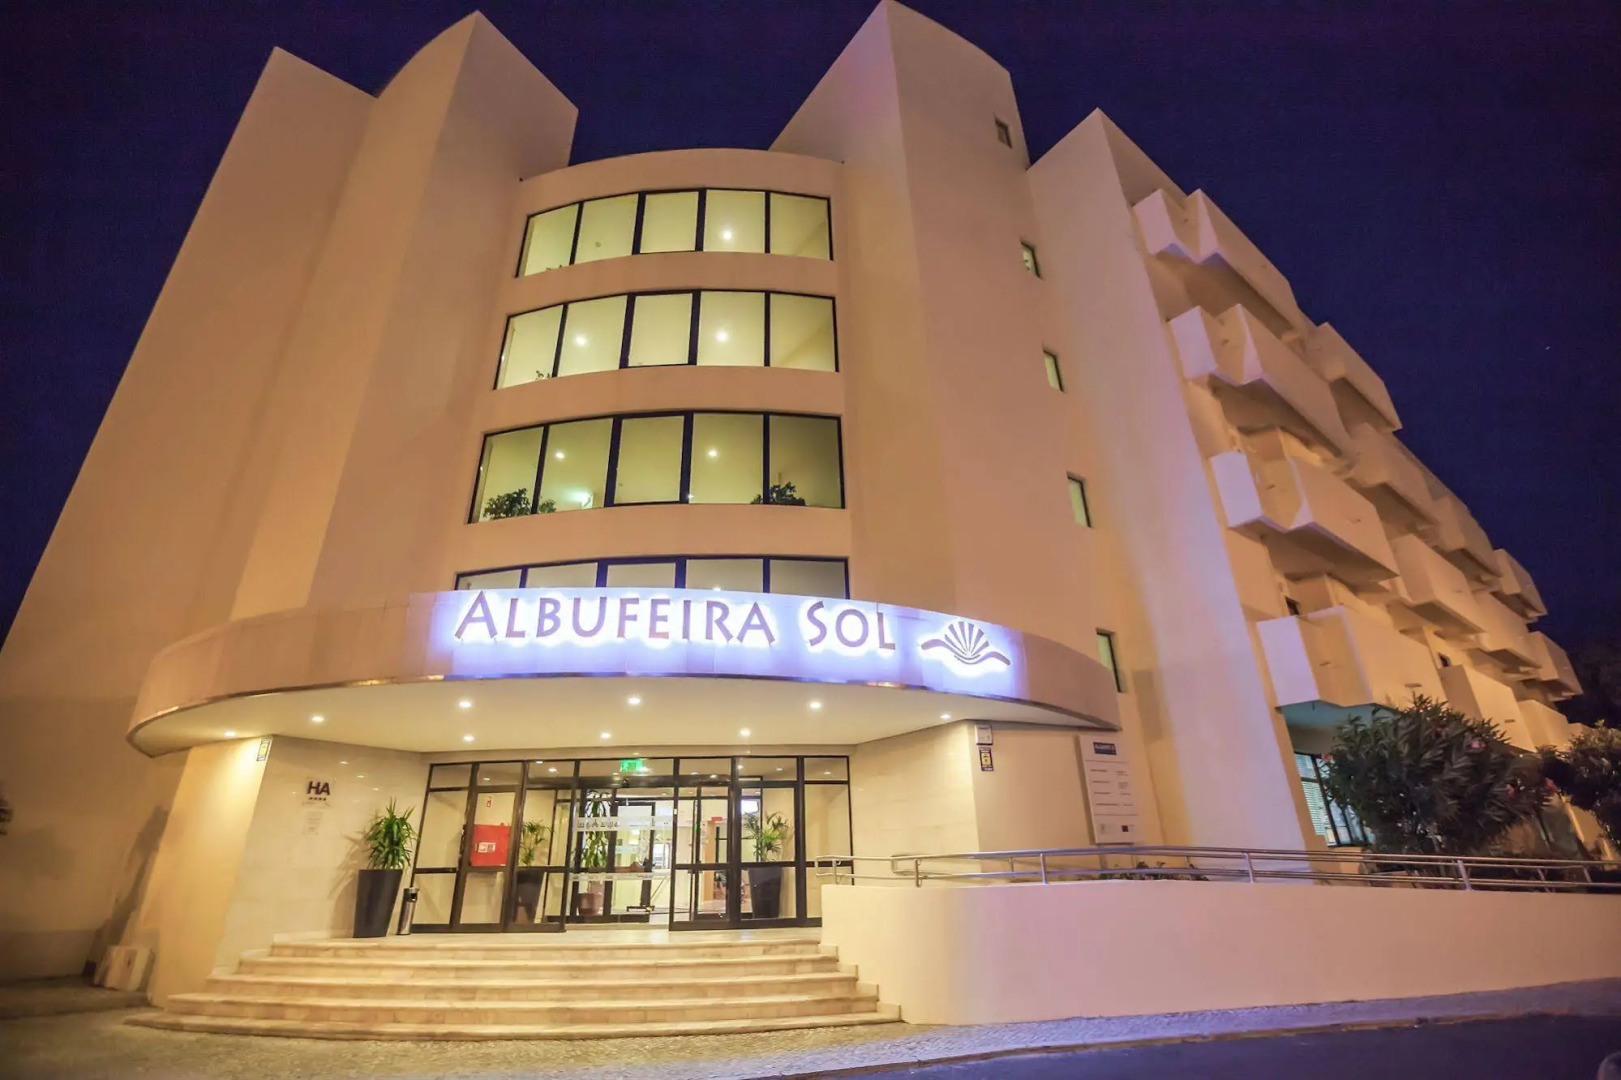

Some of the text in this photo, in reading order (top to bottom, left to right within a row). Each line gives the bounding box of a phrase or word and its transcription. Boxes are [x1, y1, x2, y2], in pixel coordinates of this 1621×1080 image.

[454, 590, 896, 650] ALBUFEIRA SOL
[307, 781, 331, 796] HA
